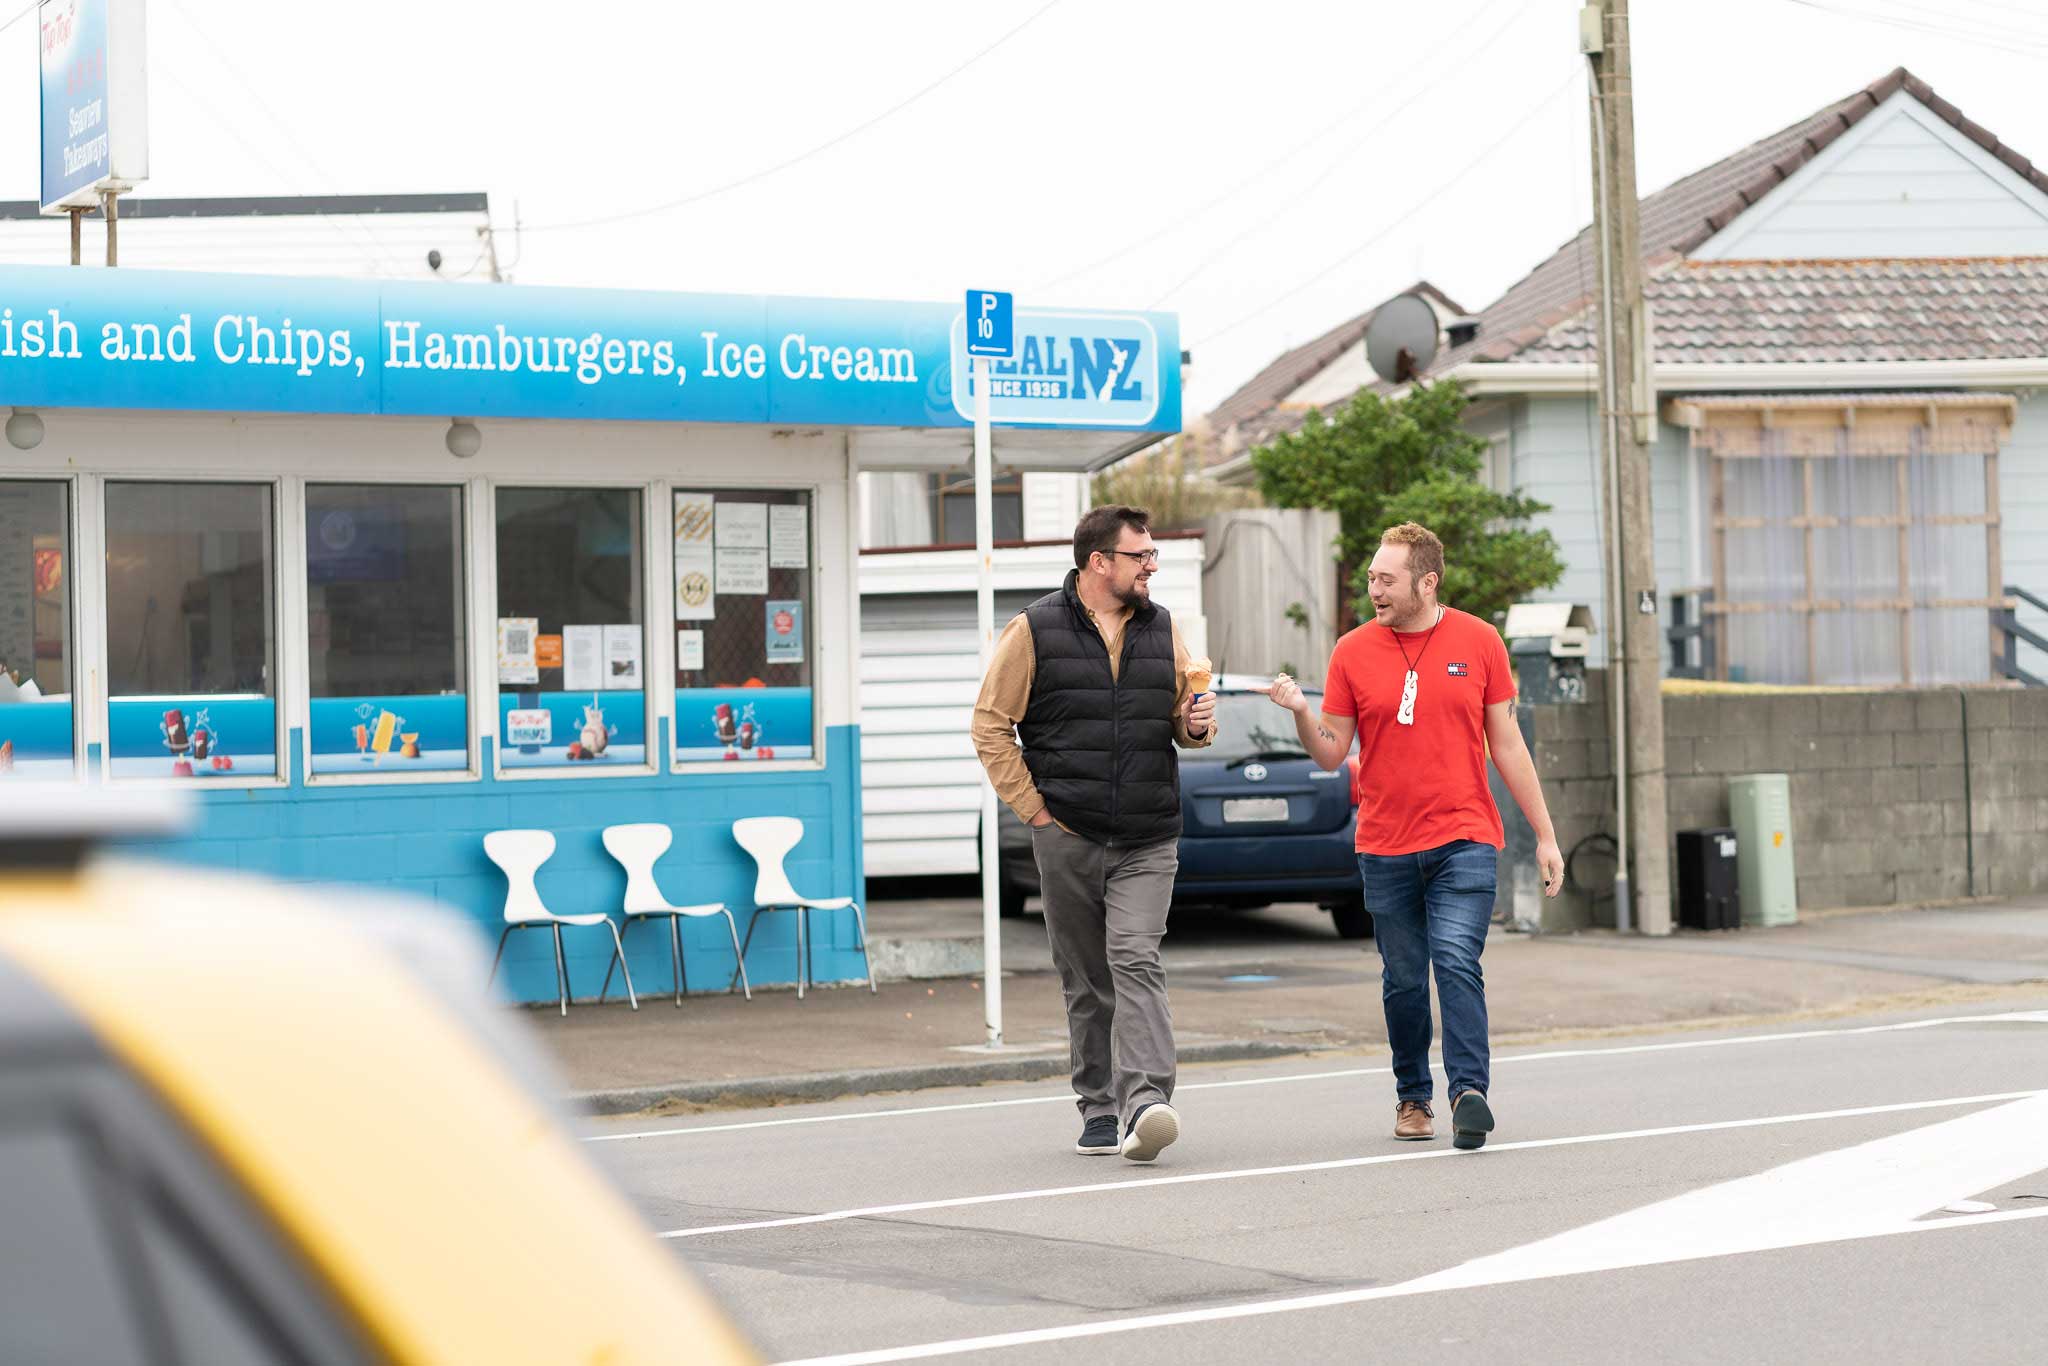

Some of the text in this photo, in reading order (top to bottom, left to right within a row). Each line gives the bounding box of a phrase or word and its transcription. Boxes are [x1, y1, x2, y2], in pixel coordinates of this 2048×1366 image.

[981, 293, 998, 319] P
[977, 318, 994, 339] 10
[100, 314, 196, 364] and
[213, 314, 366, 377] Chips,
[384, 320, 688, 386] Hamburgers,
[701, 332, 767, 379] Ice
[779, 333, 919, 383] Cream
[1025, 381, 1061, 398] 1936
[1558, 676, 1580, 699] 92
